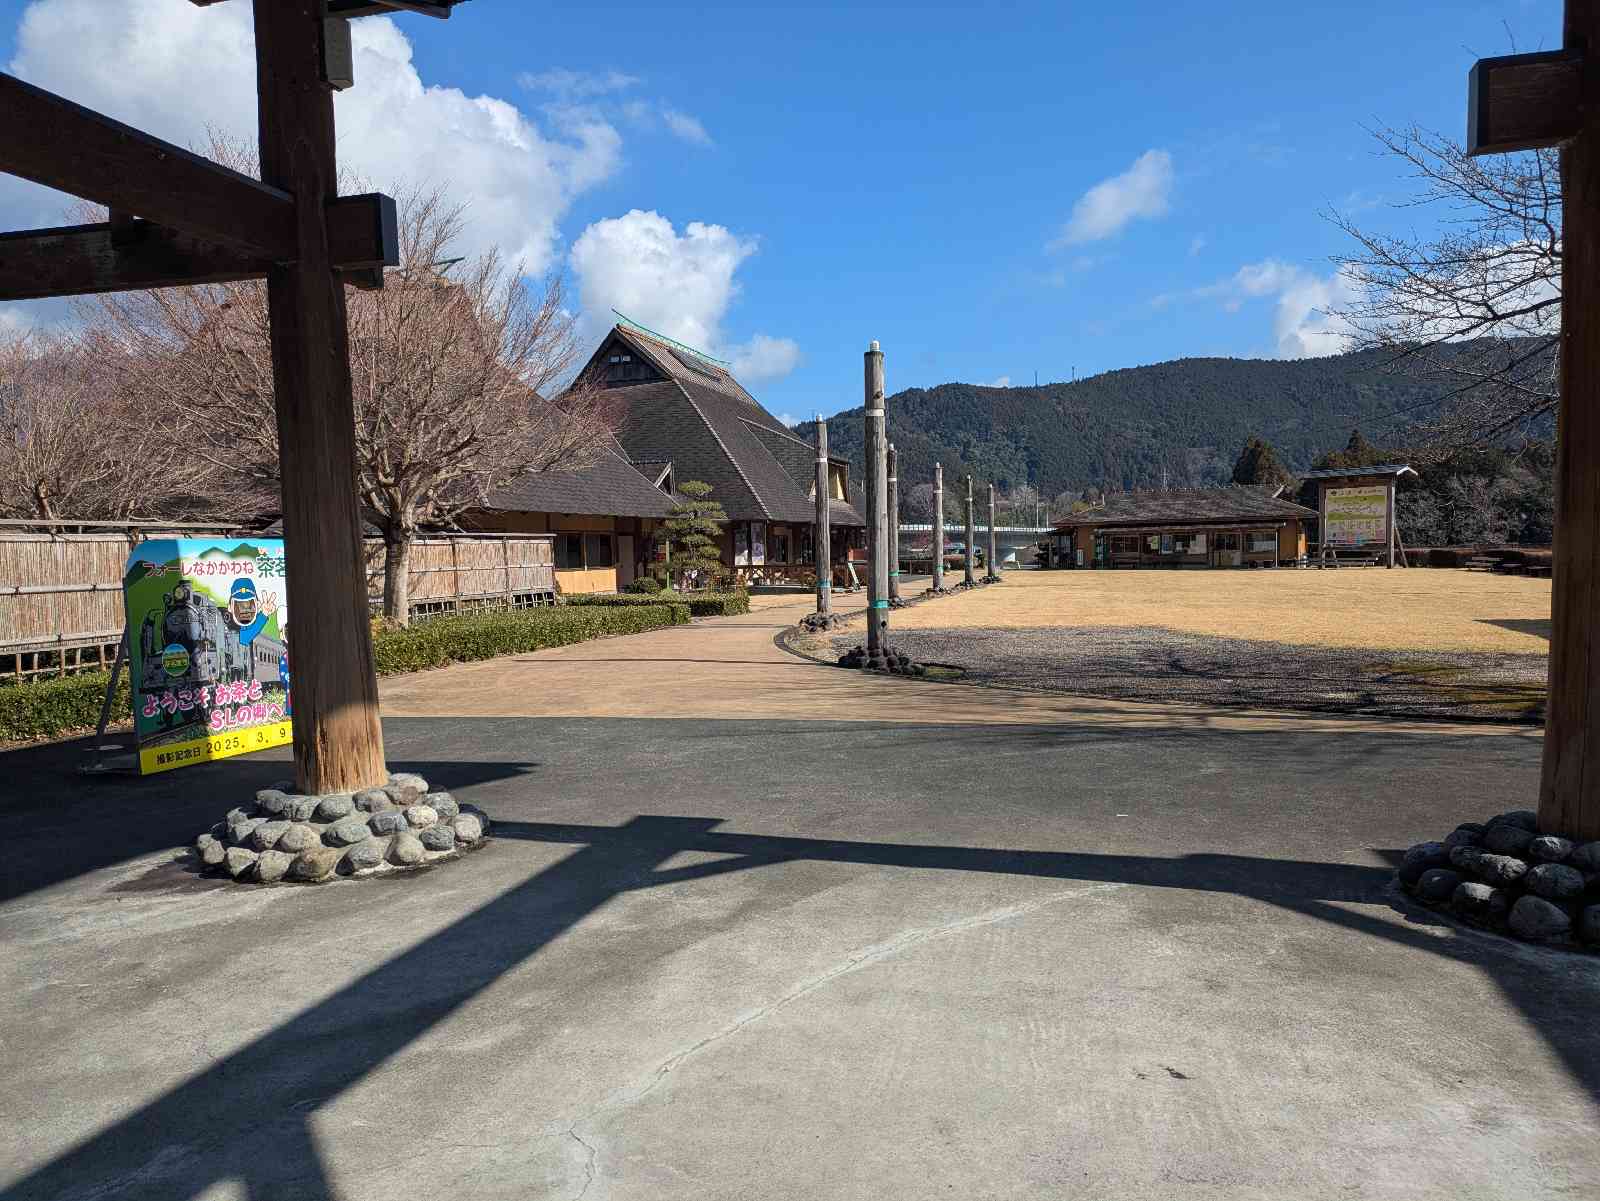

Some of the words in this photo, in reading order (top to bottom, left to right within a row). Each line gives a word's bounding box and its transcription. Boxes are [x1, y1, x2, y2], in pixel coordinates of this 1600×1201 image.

[143, 686, 211, 717] ようこそ
[215, 679, 263, 705] お茶と
[210, 703, 284, 730] SLの郷へ
[156, 747, 201, 766] 撮影記念日
[279, 727, 287, 738] 9
